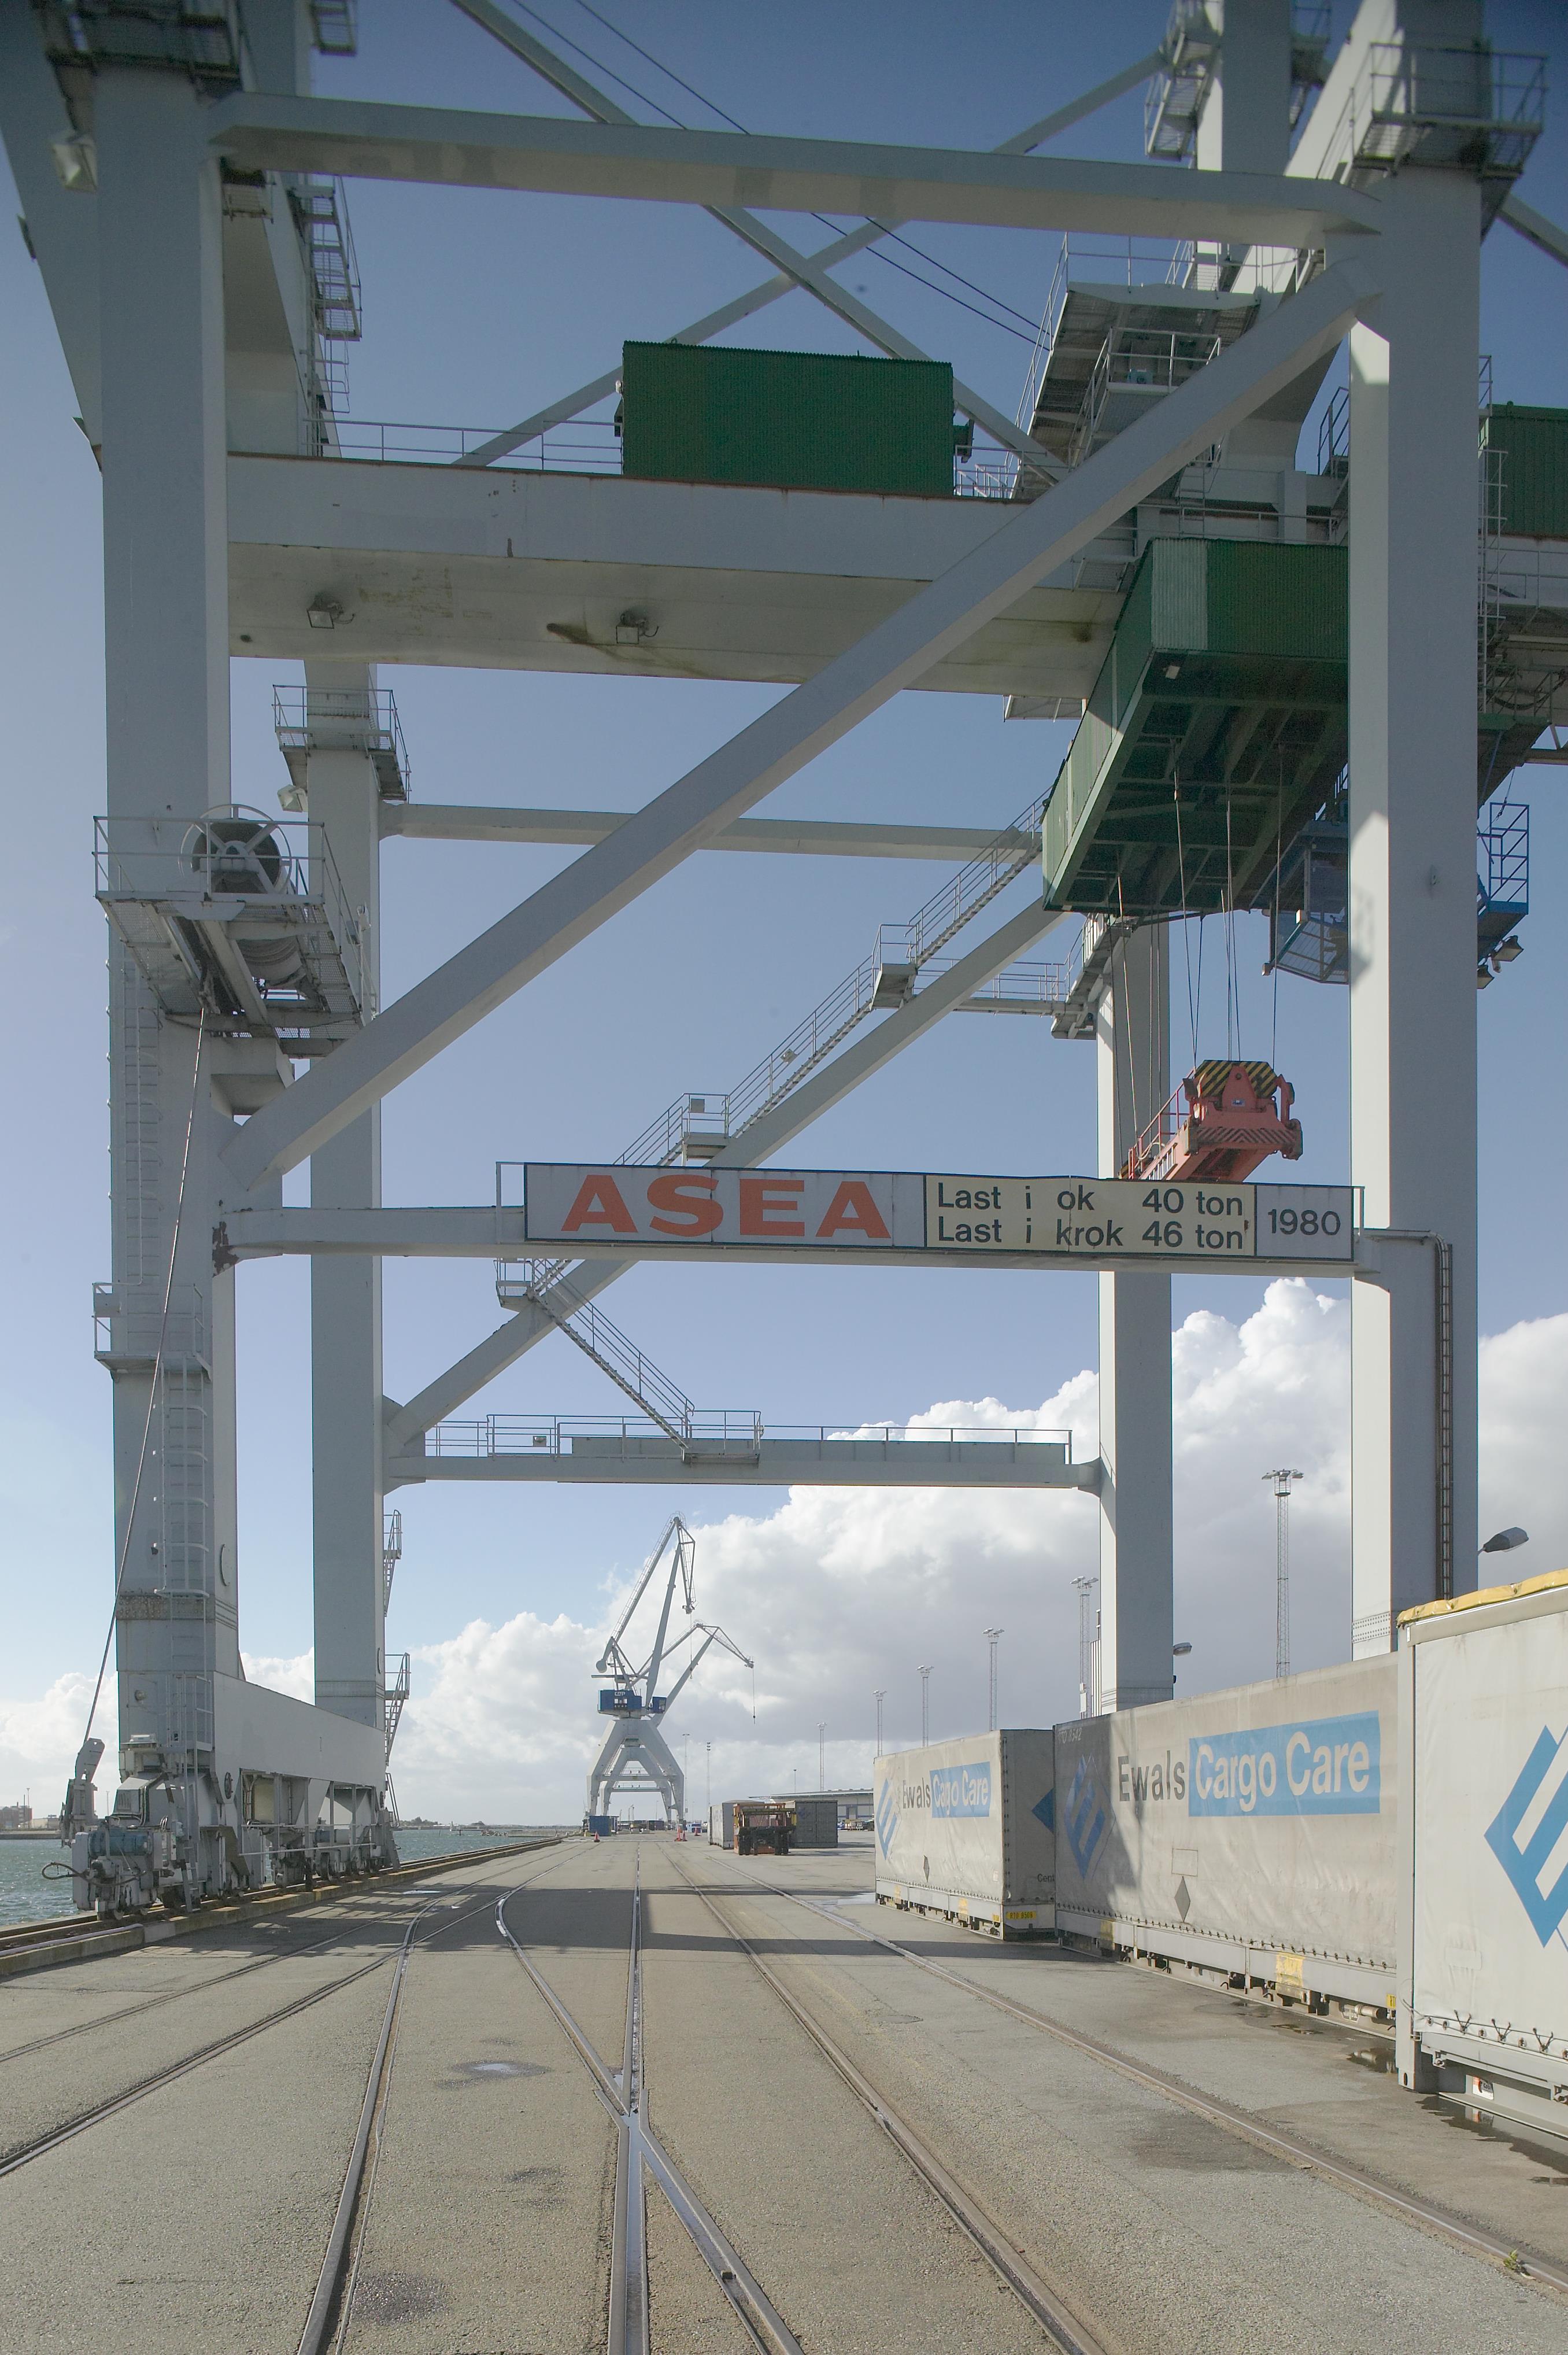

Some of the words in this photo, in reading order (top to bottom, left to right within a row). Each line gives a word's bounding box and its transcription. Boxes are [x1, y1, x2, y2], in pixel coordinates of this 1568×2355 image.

[560, 1174, 892, 1239] ASEA
[937, 1182, 1001, 1210] Last
[1026, 1186, 1031, 1210] i
[1057, 1184, 1094, 1211] ok
[1142, 1188, 1184, 1213] 40
[1196, 1191, 1243, 1216] ton
[937, 1216, 1003, 1243] Last
[1026, 1219, 1031, 1243] i
[1056, 1219, 1123, 1247] krok
[1142, 1221, 1183, 1248] 46
[1195, 1224, 1243, 1250] ton
[1268, 1209, 1341, 1236] 1980
[903, 1777, 931, 1809] Ewals
[962, 1770, 988, 1807] Care
[1118, 1750, 1185, 1802] Ewals
[1195, 1744, 1277, 1812] Cargo
[1286, 1732, 1370, 1796] Care
